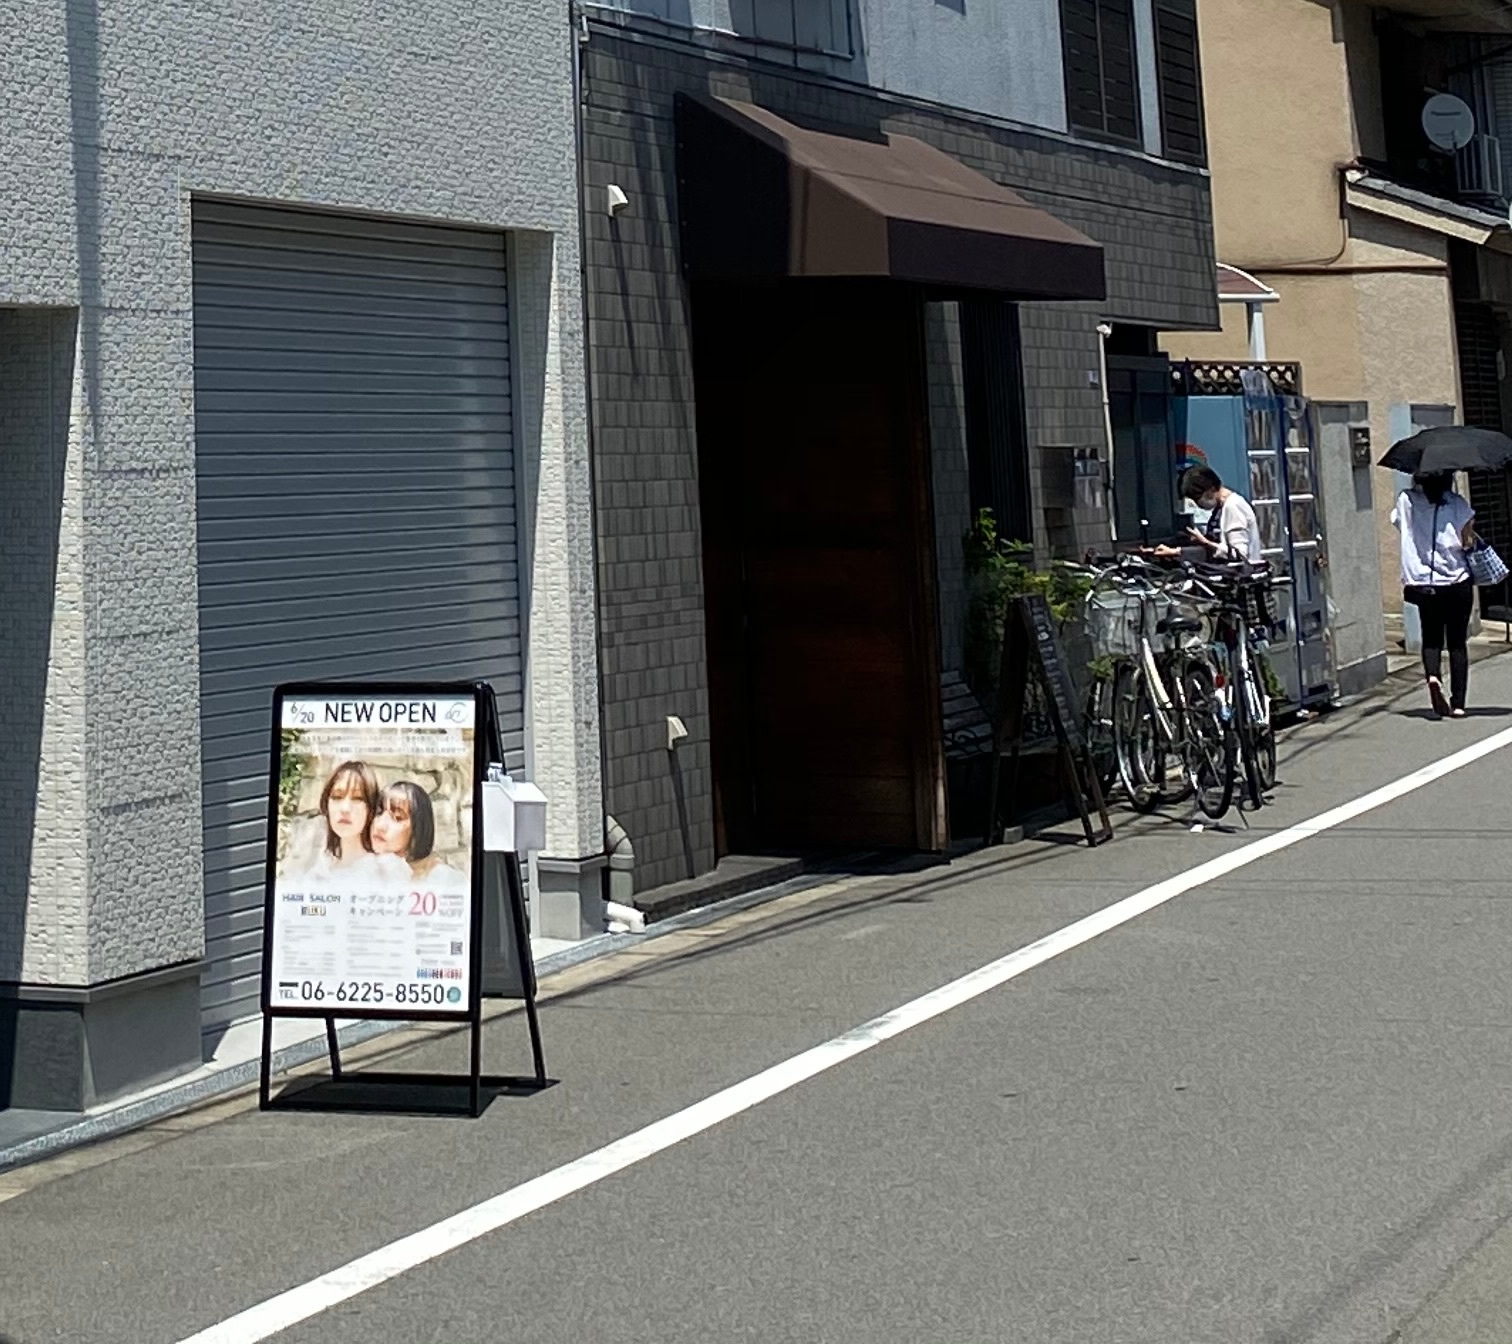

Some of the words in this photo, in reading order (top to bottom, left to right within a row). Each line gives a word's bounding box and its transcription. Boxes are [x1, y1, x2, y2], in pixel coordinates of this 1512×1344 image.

[324, 702, 375, 723] NEW
[379, 702, 437, 723] OPEN
[282, 893, 305, 903] HAIR
[309, 894, 341, 904] SALON
[408, 891, 437, 916] 20
[301, 980, 445, 1004] 06-6225-8550
